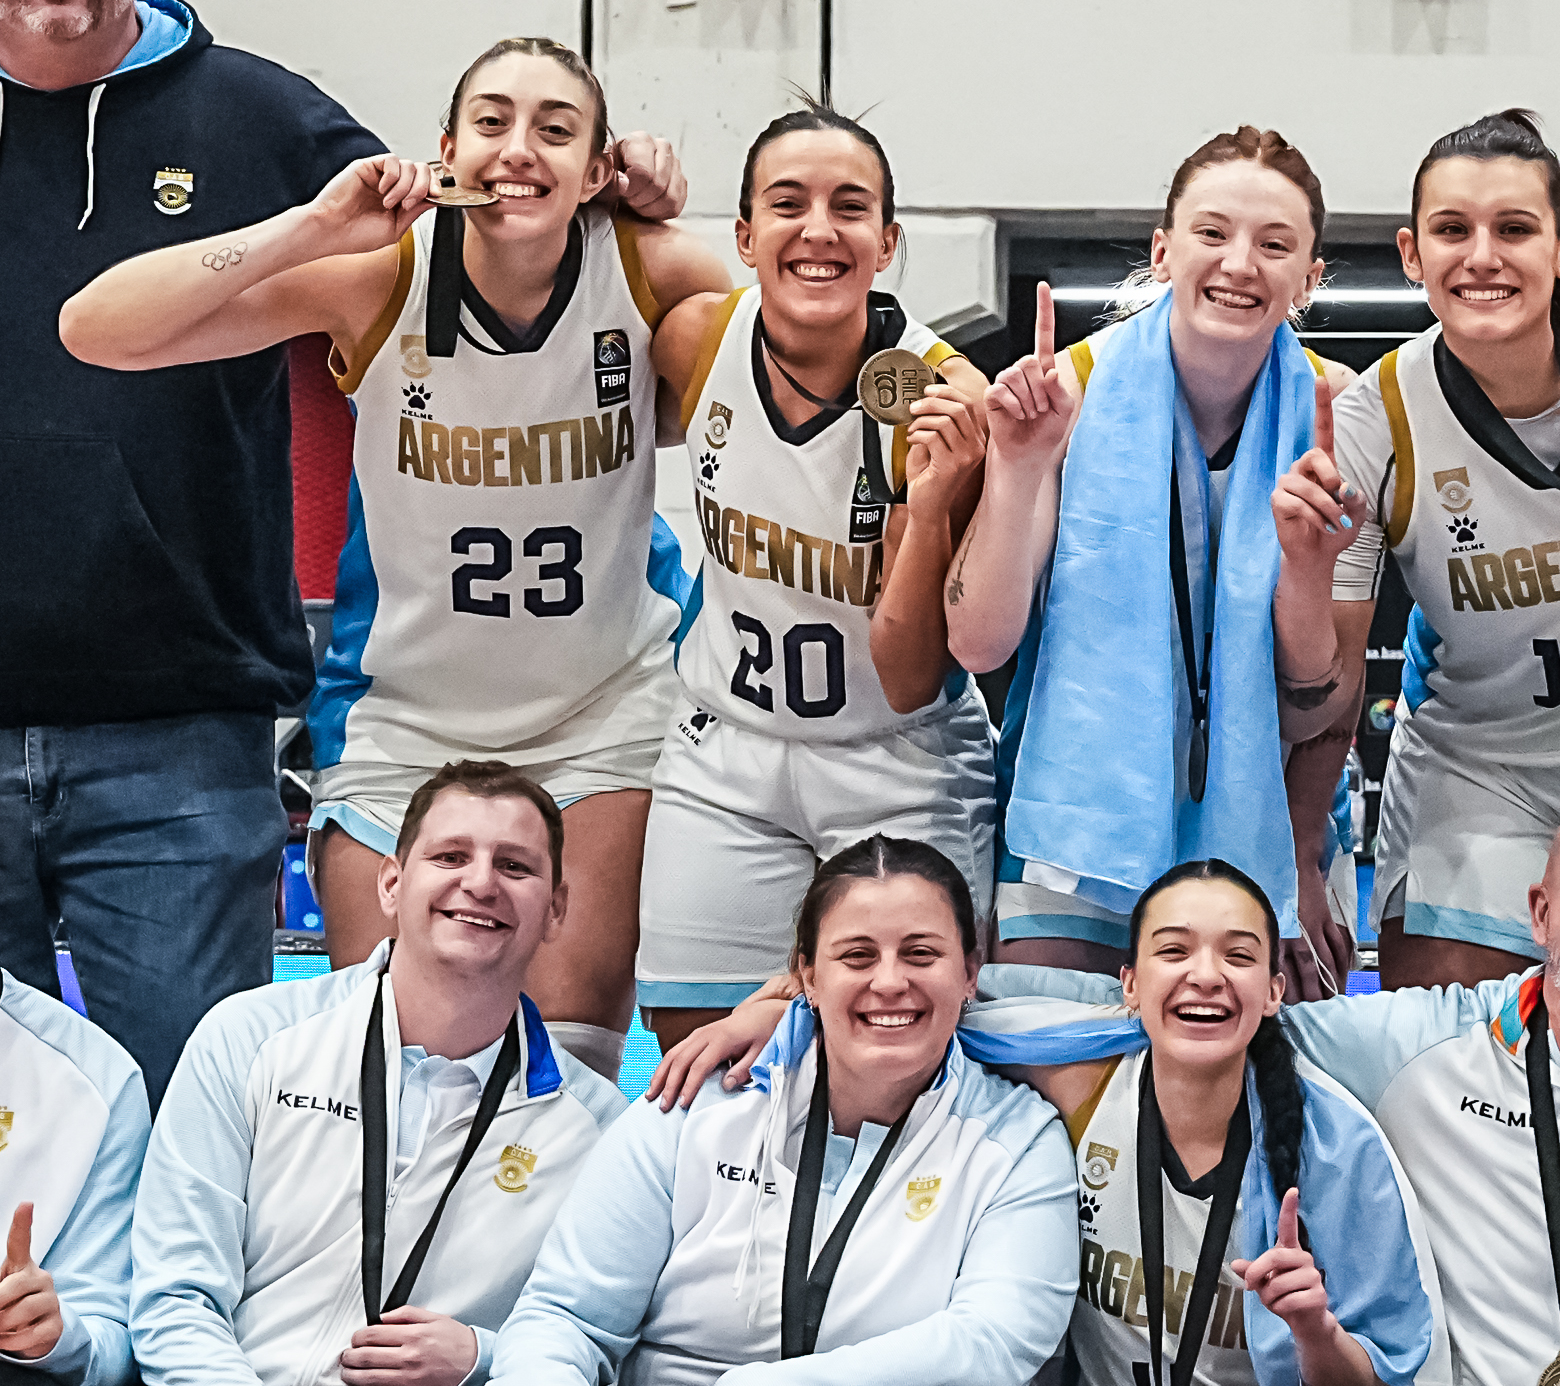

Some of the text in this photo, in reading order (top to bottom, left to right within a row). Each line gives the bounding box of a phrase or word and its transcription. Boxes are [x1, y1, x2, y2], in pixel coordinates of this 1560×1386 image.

[601, 373, 626, 390] FIBA
[401, 409, 434, 421] KELME
[397, 407, 635, 489] ARGENTINA
[855, 509, 880, 525] FIBA
[1451, 542, 1486, 554] KELME
[449, 524, 584, 619] 23
[730, 611, 847, 719] 20
[278, 1090, 358, 1121] KELME
[1460, 1096, 1535, 1129] KELM
